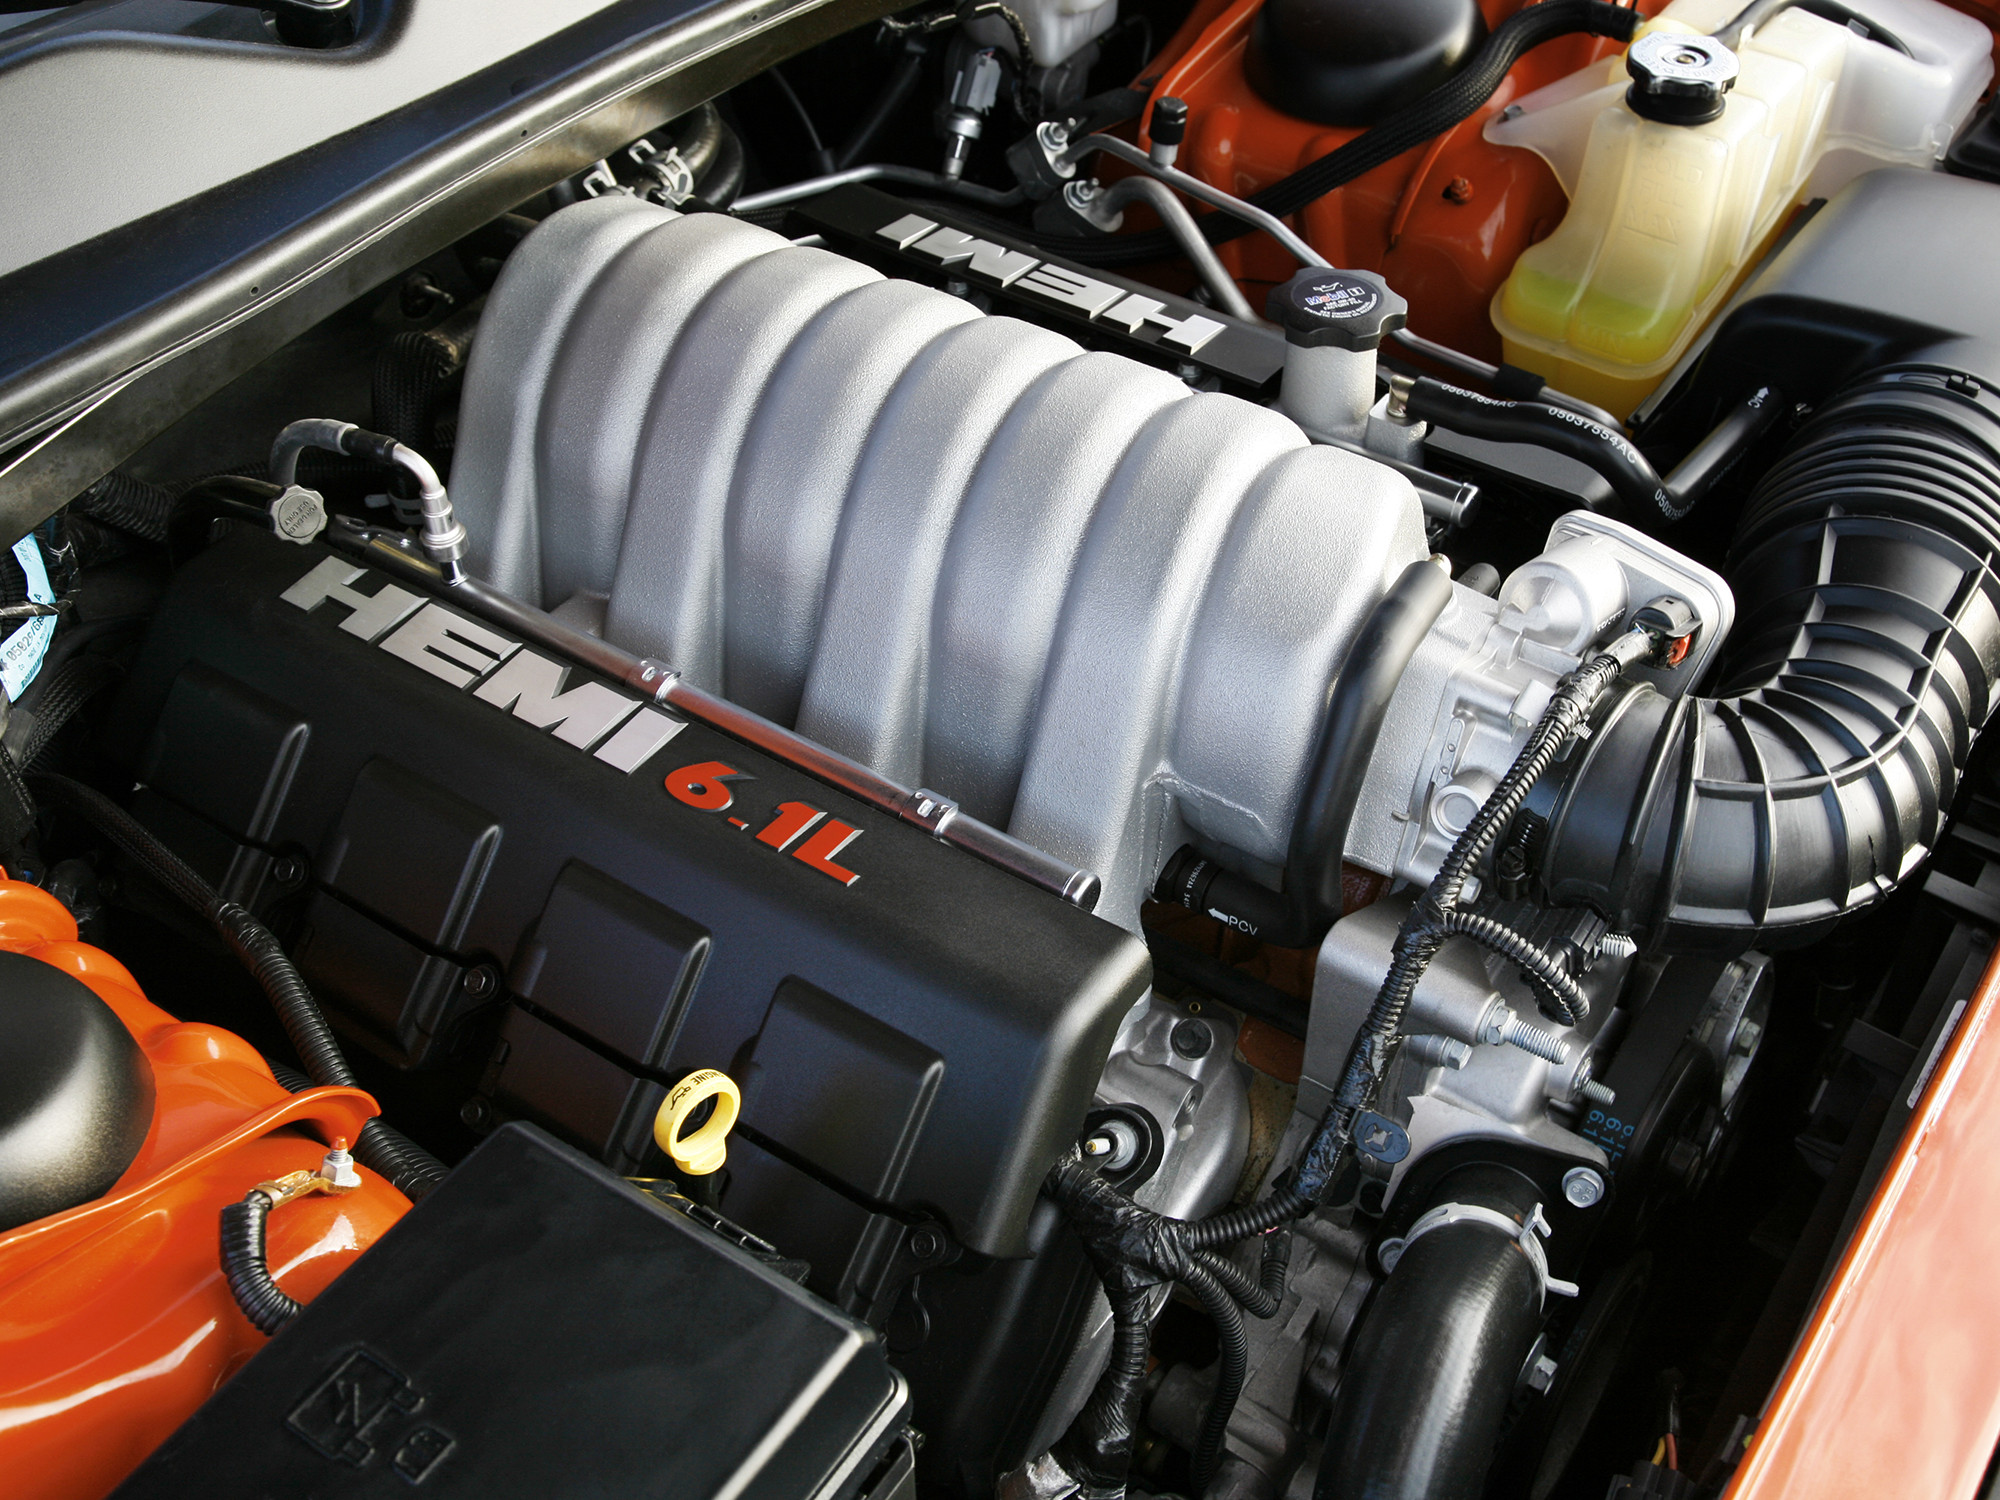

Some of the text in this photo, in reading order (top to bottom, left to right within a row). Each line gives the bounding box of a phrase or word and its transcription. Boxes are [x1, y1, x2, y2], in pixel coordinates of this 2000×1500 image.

[876, 213, 1229, 356] HEMI
[1305, 289, 1349, 306] Mobil
[1548, 406, 1639, 475] 05037554AC
[279, 555, 690, 775] HEMI
[663, 760, 865, 887] 6.1L
[1228, 915, 1258, 936] PCV
